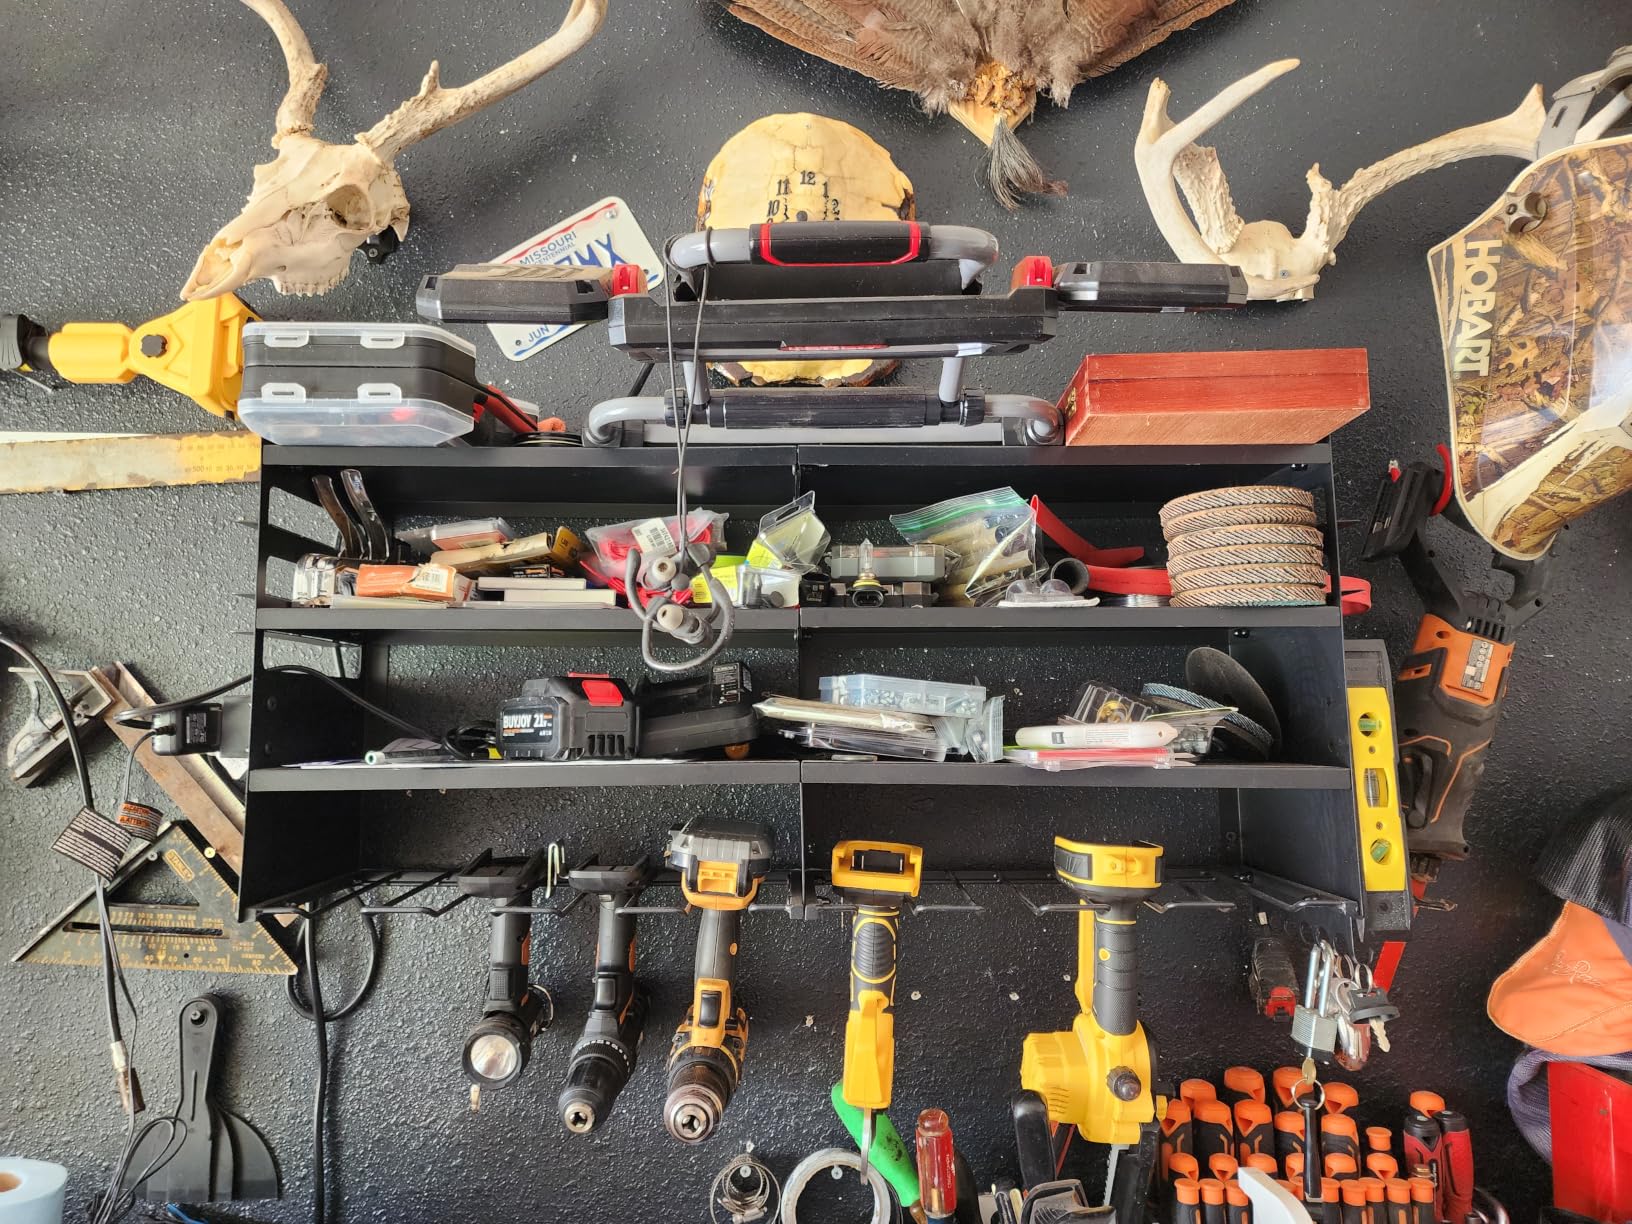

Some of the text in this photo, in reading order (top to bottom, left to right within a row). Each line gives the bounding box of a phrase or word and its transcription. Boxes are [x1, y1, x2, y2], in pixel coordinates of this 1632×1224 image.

[776, 177, 791, 196] 11
[800, 170, 816, 186] 12
[822, 181, 829, 199] 1
[767, 199, 780, 217] 10
[831, 198, 840, 216] 2
[520, 231, 577, 264] MISSOURI
[1454, 239, 1503, 377] HOBART
[528, 325, 550, 343] JUN
[503, 714, 532, 729] BUYJOY
